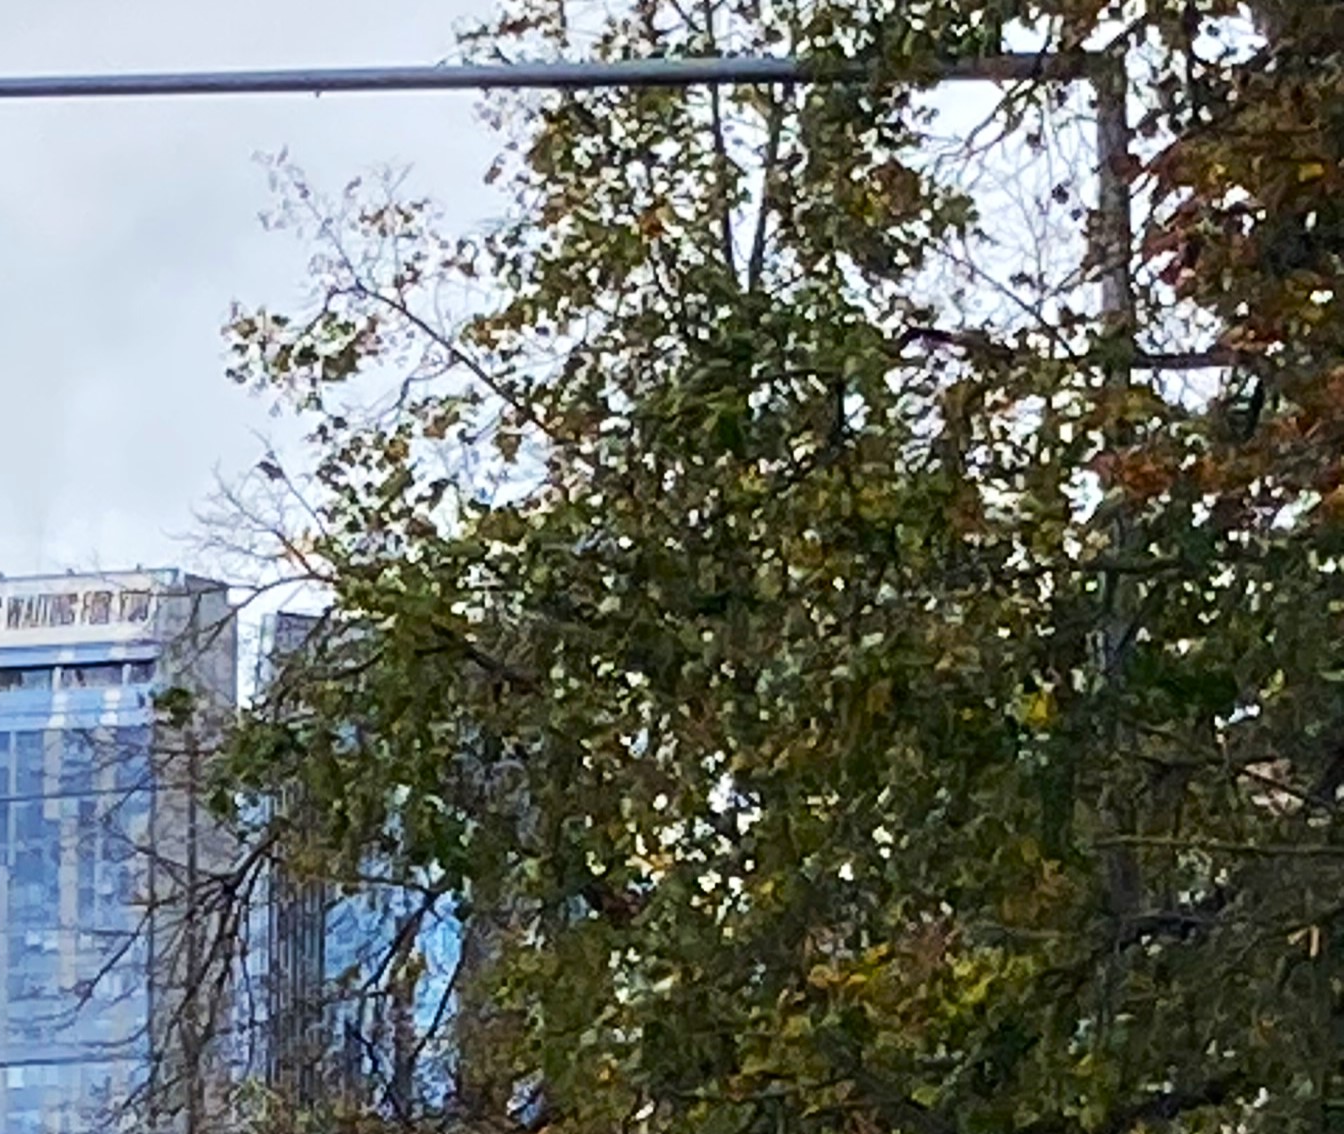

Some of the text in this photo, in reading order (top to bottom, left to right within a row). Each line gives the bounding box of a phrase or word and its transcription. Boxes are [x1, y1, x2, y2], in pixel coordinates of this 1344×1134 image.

[6, 592, 78, 630] WAITING
[80, 590, 113, 625] FOR
[118, 588, 152, 623] YOU
